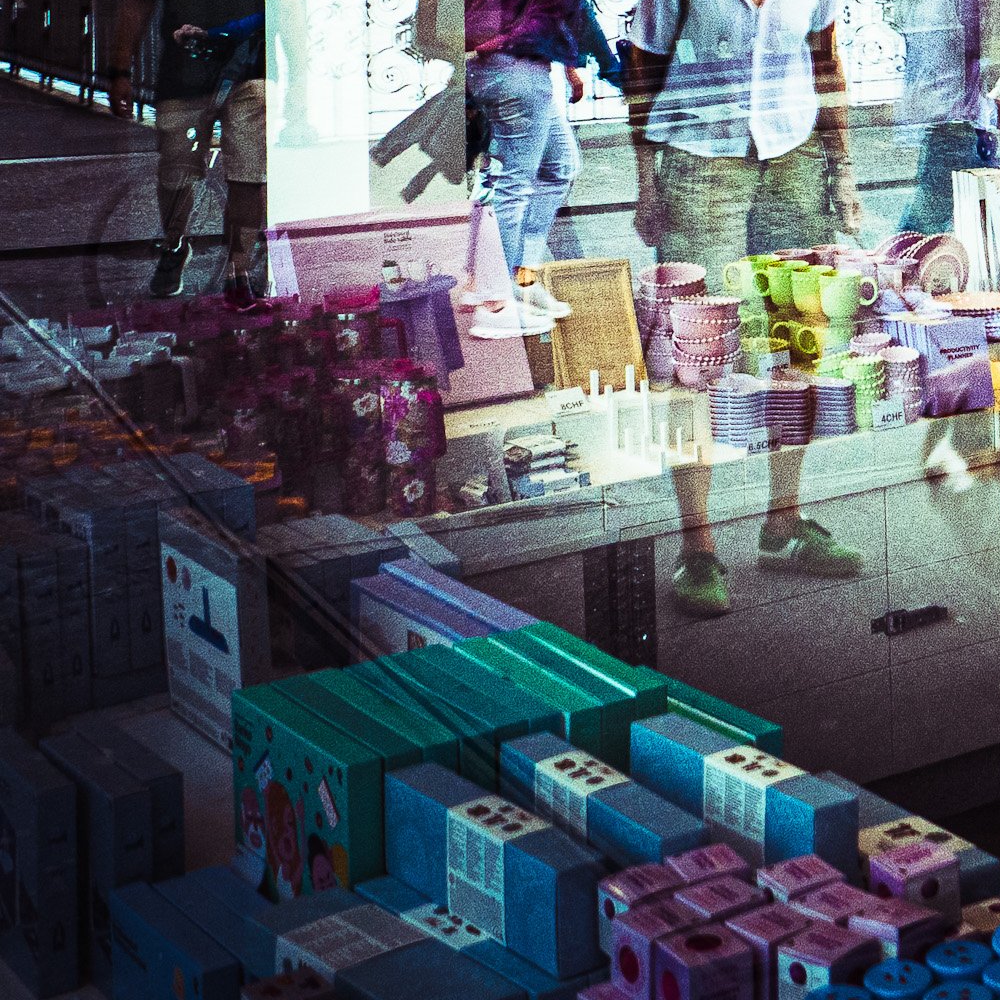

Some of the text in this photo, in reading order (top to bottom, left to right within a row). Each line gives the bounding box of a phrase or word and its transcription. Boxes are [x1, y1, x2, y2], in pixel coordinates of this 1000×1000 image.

[939, 344, 980, 354] PRODUCTIVITY
[947, 353, 974, 361] PLANNER
[881, 411, 903, 422] 4CHF
